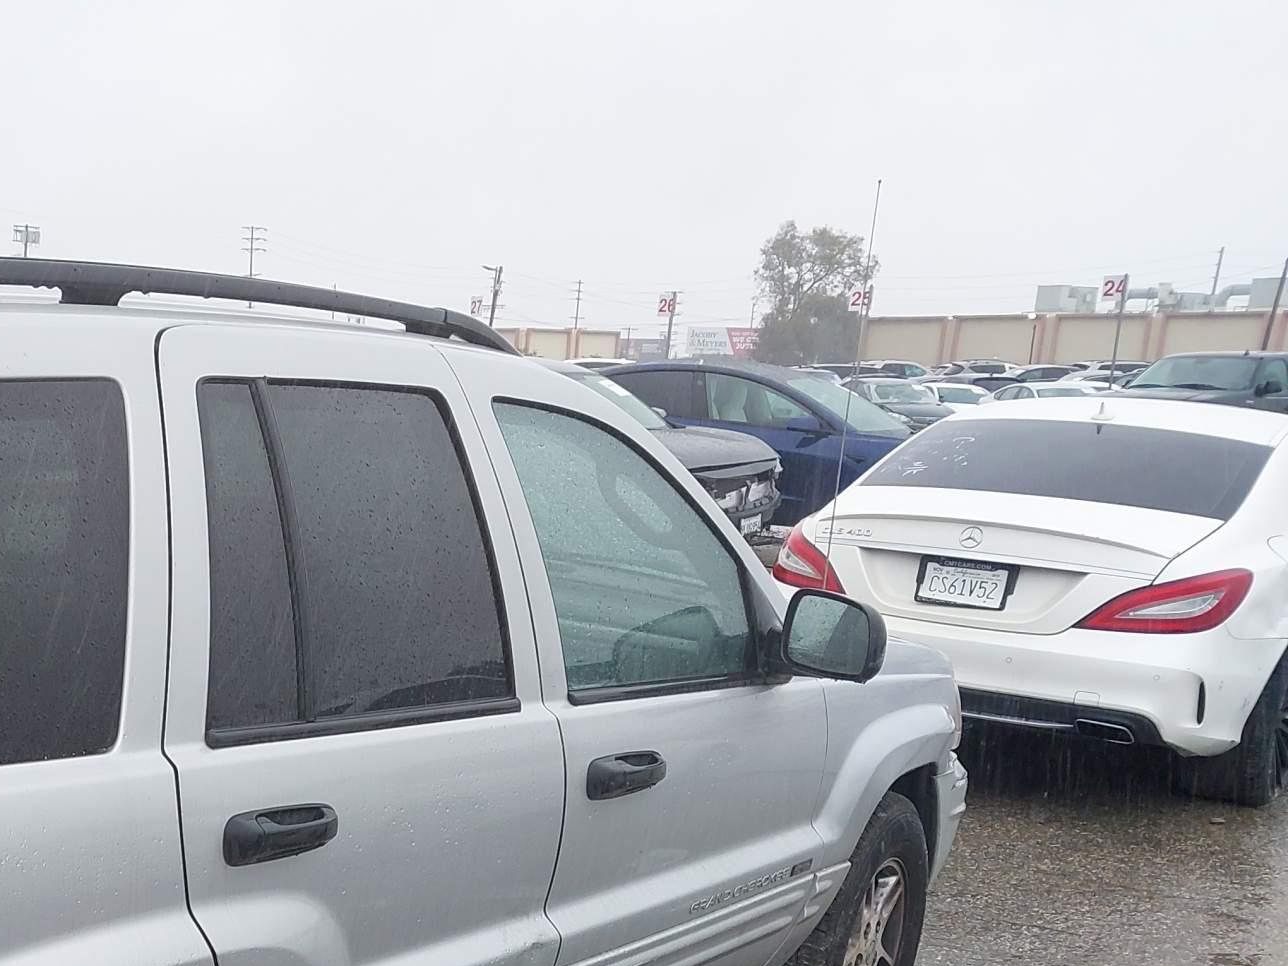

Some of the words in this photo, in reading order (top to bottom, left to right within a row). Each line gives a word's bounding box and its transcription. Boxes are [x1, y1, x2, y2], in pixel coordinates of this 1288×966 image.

[1103, 279, 1126, 297] 24
[658, 298, 675, 313] 26
[850, 290, 870, 306] 25
[470, 299, 482, 314] 27
[928, 575, 999, 601] CS61V52
